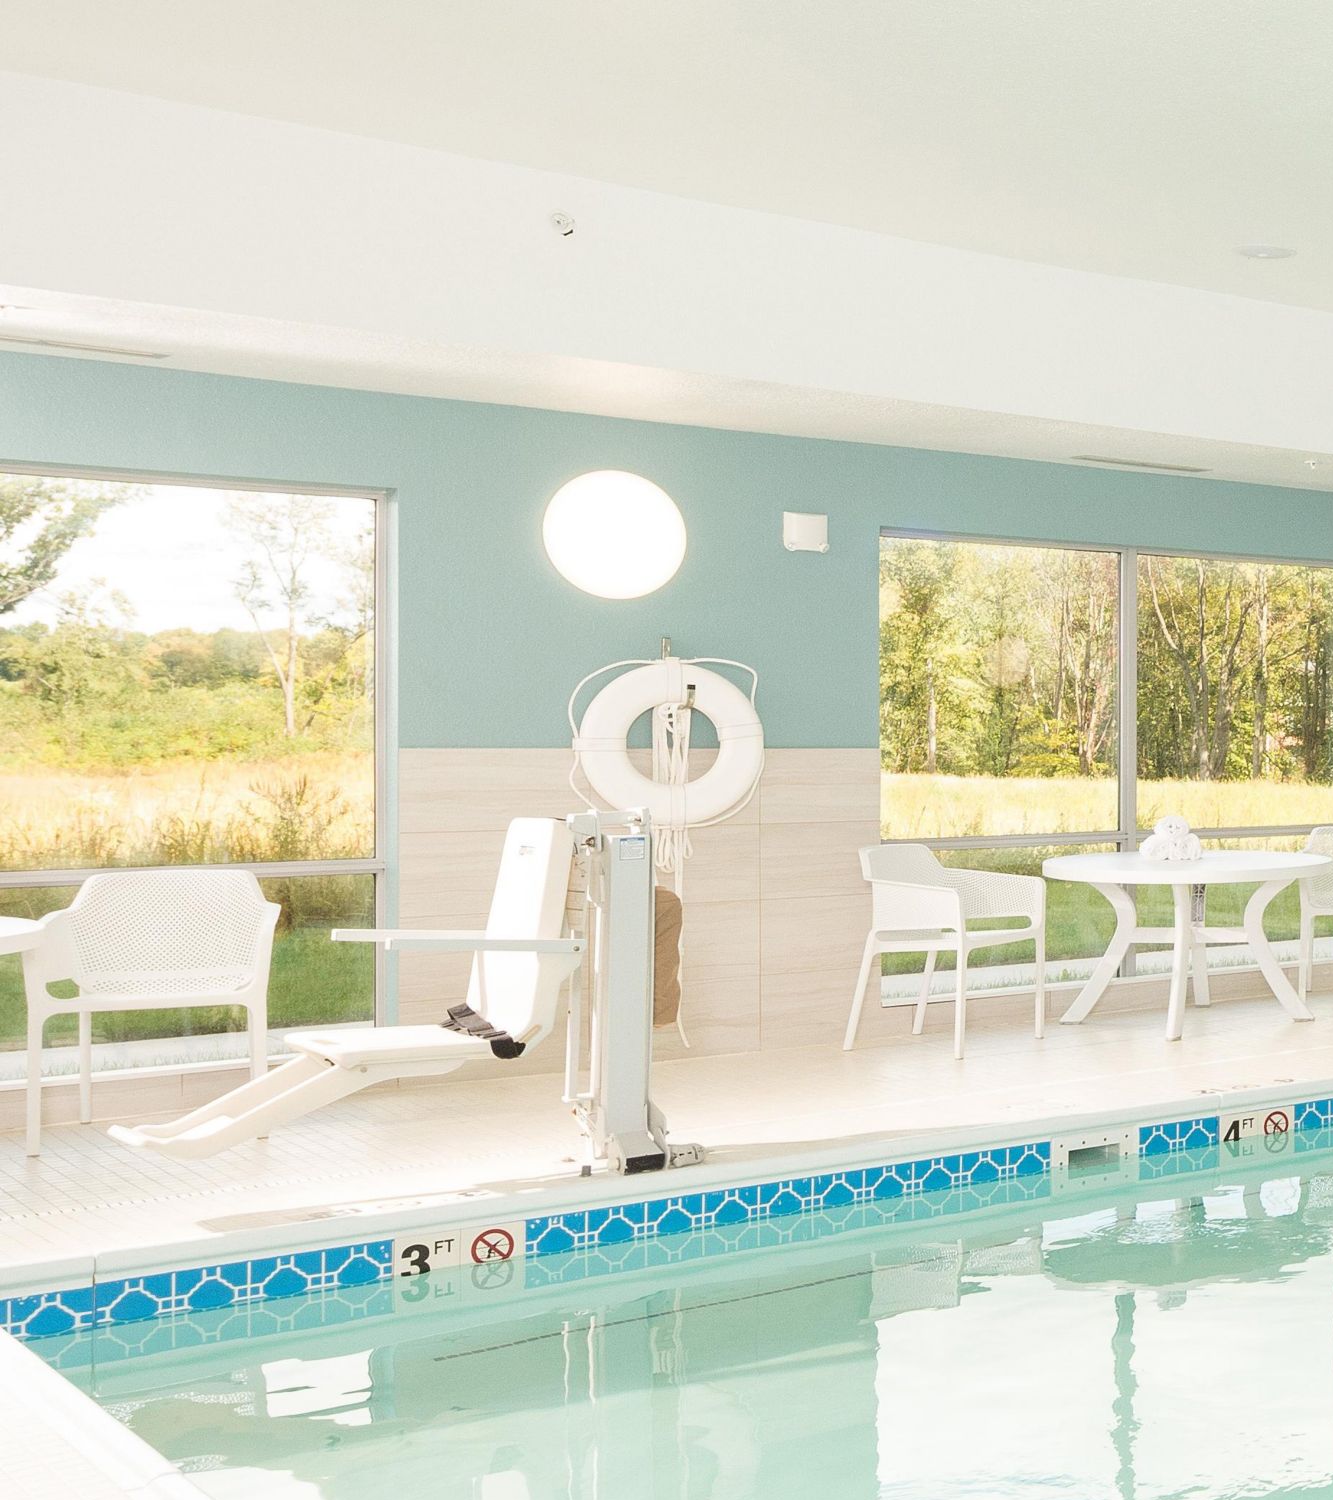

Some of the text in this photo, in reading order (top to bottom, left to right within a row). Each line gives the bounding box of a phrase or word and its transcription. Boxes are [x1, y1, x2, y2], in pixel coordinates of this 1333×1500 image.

[1223, 1117, 1255, 1142] 4 FT
[401, 1238, 455, 1277] 3 FT
